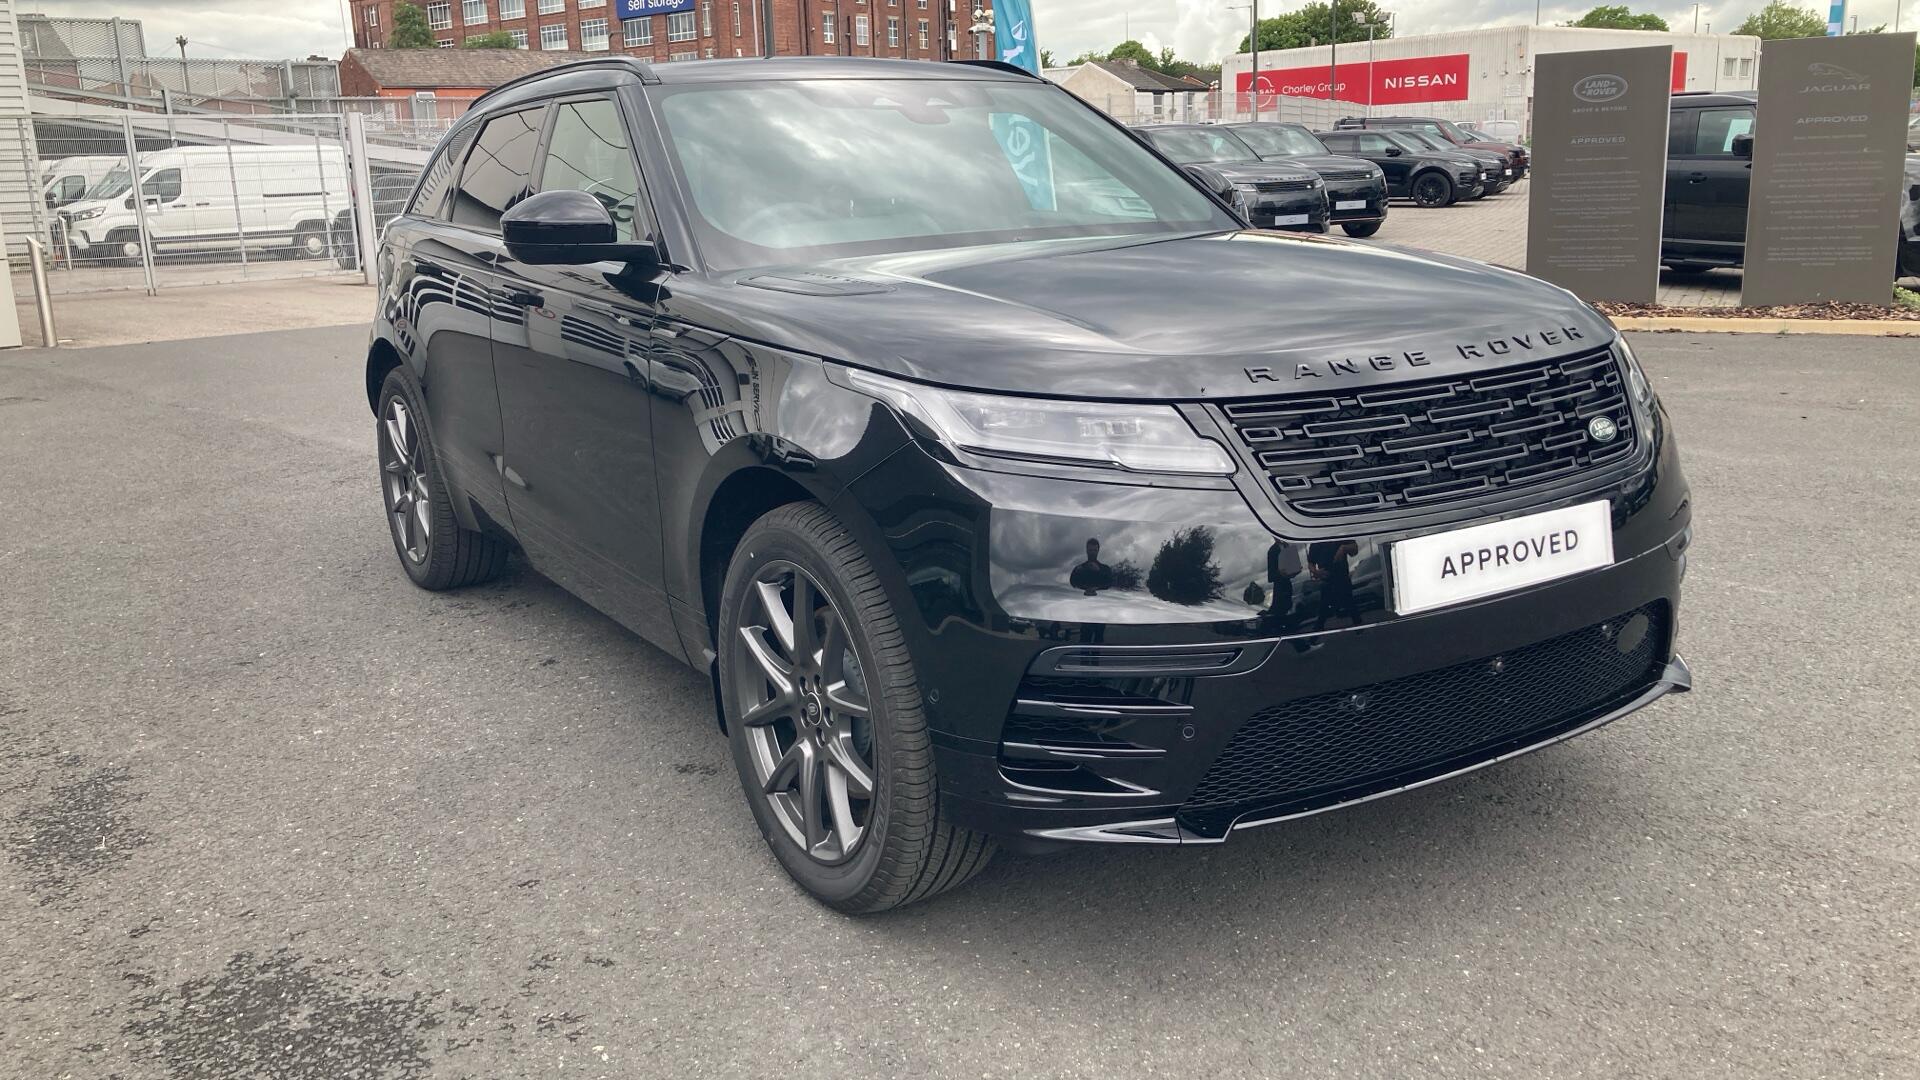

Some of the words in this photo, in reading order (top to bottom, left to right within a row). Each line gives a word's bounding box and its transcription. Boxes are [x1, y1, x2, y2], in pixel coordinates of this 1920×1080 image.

[1385, 73, 1457, 89] NISSAN
[1585, 80, 1610, 89] LAND
[1282, 84, 1316, 95] Chorley
[1586, 87, 1618, 97] ROVER
[1799, 83, 1871, 94] JAGUAR
[1796, 114, 1868, 125] APPROVED
[1570, 136, 1626, 145] APPROVED
[1243, 350, 1432, 383] RANGE
[1456, 327, 1585, 360] ROVER
[1440, 528, 1580, 580] APPROVED
